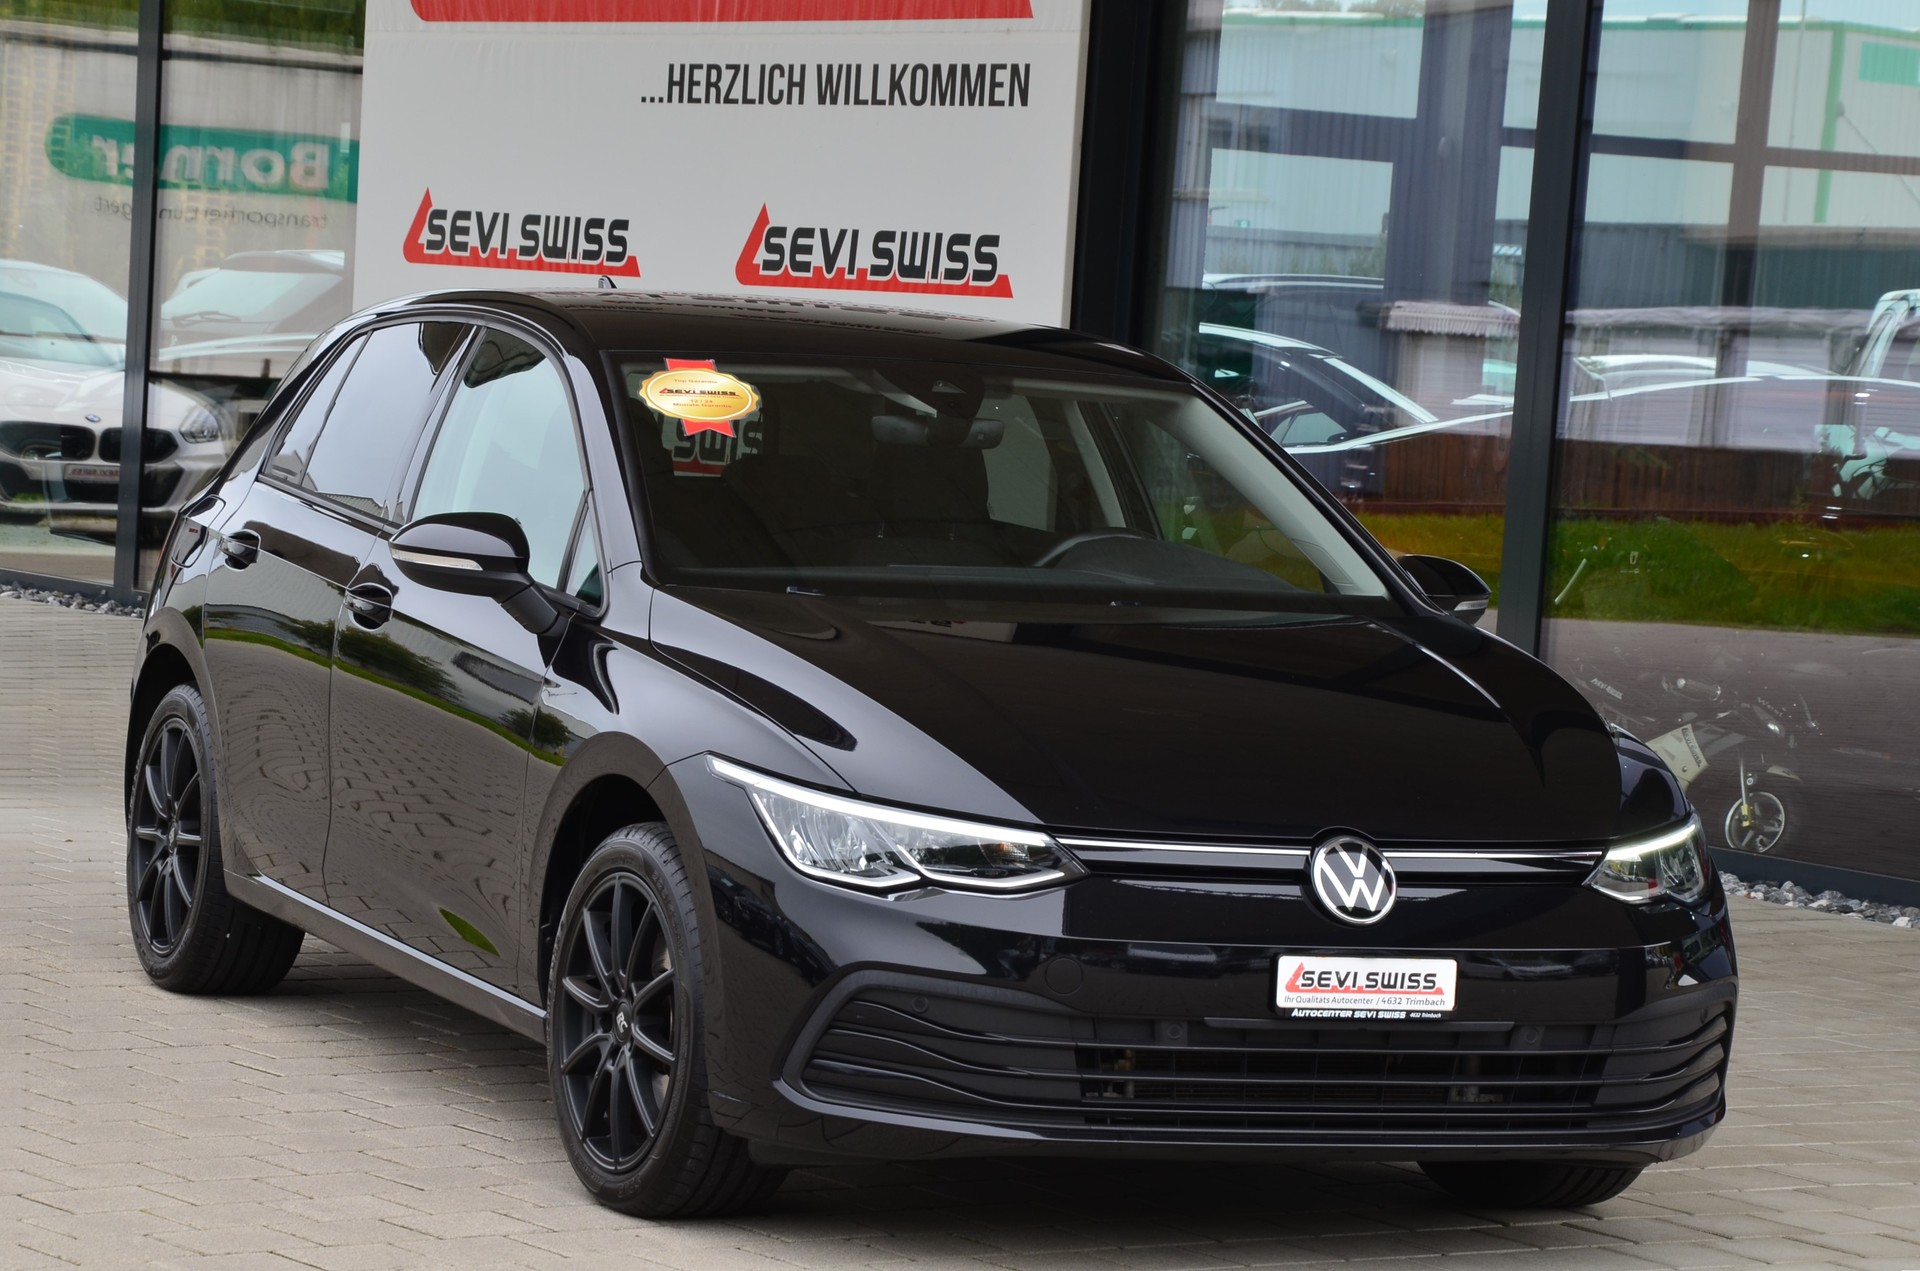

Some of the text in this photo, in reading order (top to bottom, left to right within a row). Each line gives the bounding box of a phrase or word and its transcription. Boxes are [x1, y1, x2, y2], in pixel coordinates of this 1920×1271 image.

[640, 62, 1031, 107] ...HERZLICH WILLKOMMEN
[425, 207, 629, 264] SEVI SWISS
[761, 226, 1001, 281] SEVI SWISS
[1300, 970, 1437, 990] SEVI SWISS
[1284, 995, 1295, 1004] Ihr
[1331, 996, 1374, 1005] Autocenter
[1381, 996, 1403, 1005] 4632
[1405, 997, 1446, 1007] Trimbach
[1353, 1010, 1376, 1019] SEVI
[1377, 1010, 1407, 1019] SWISS
